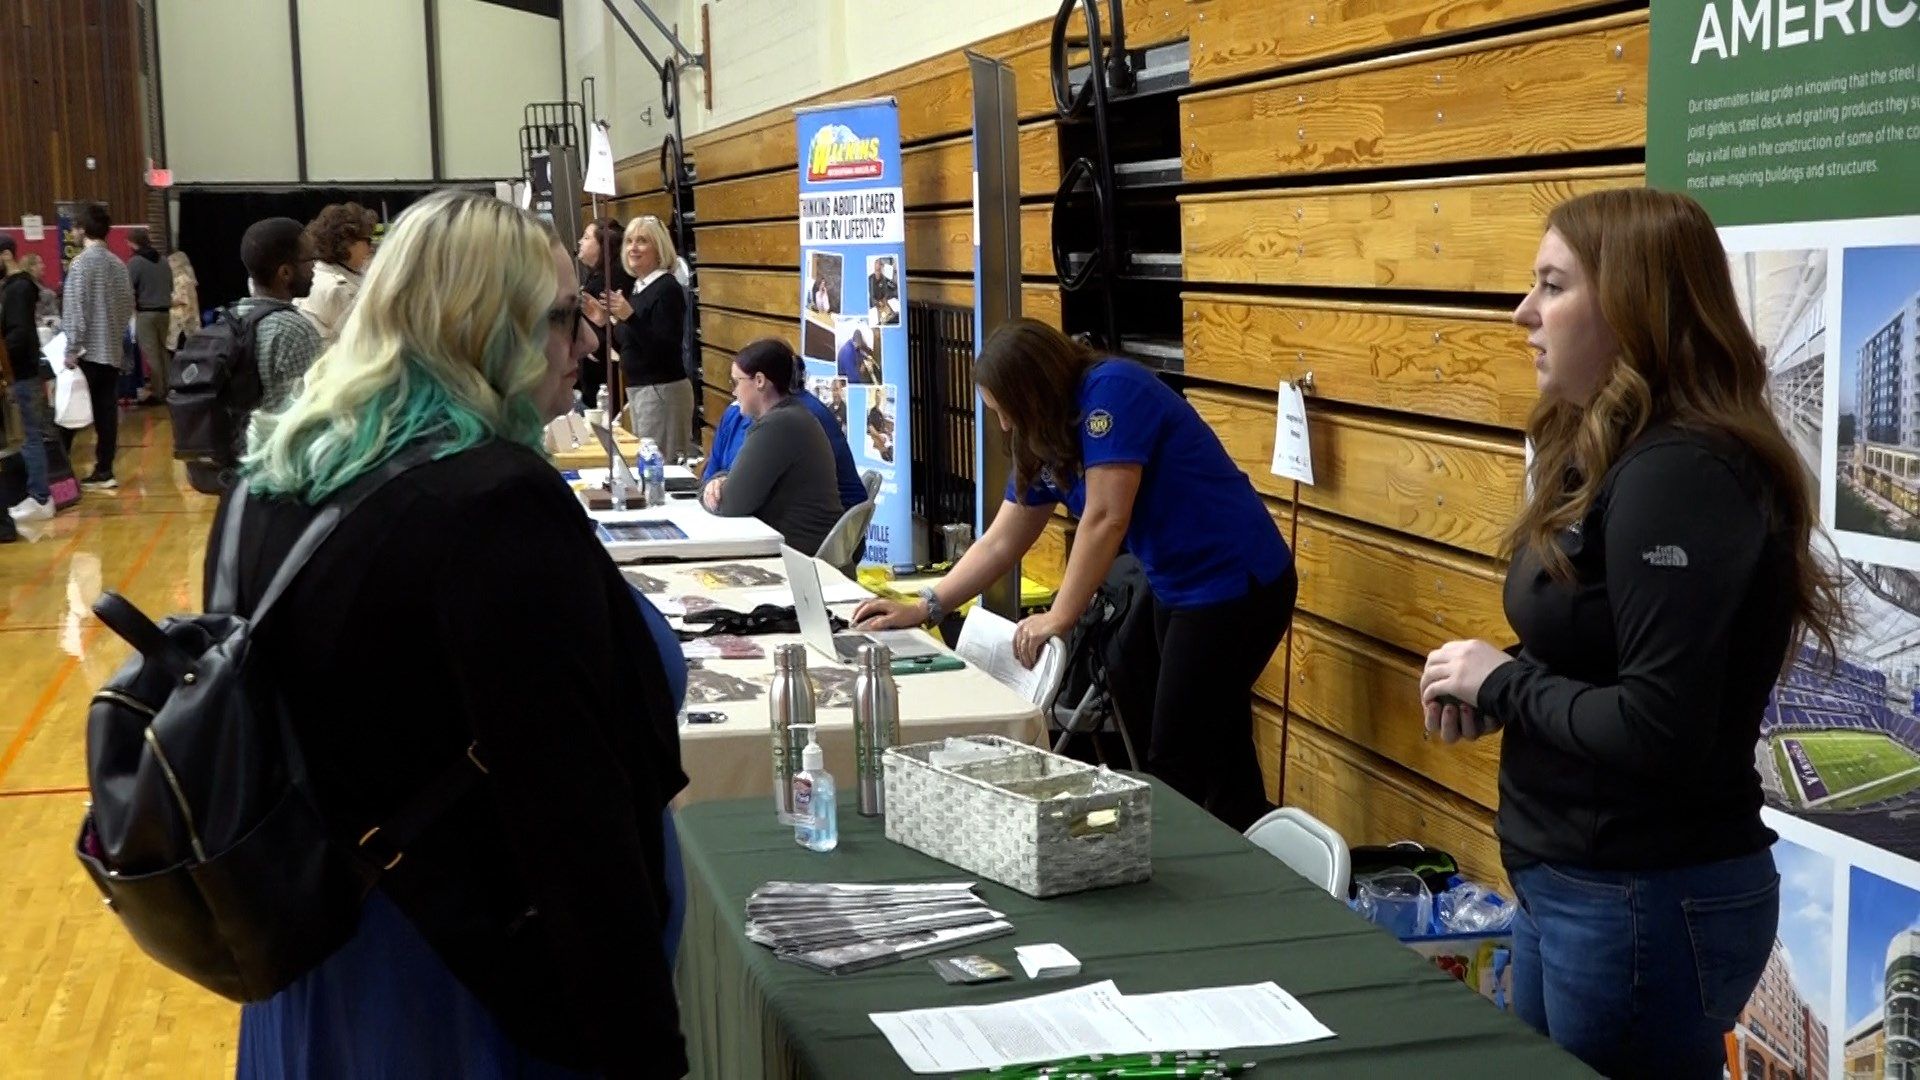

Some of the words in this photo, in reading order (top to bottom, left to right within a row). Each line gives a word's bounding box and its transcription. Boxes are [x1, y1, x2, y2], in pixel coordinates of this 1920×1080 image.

[1688, 99, 1704, 114] Our
[1704, 93, 1749, 111] teammates
[1750, 89, 1770, 104] take
[1771, 84, 1794, 105] pride
[1795, 83, 1803, 96] in
[1804, 77, 1847, 94] knowing
[1849, 72, 1868, 89] that
[1871, 69, 1886, 84] the
[1889, 64, 1915, 83] steel
[1738, 115, 1759, 132] steel
[1785, 109, 1802, 126] and
[1803, 104, 1839, 128] grating
[1841, 99, 1884, 120] products
[1885, 96, 1910, 114] they
[1687, 150, 1705, 168] play
[1705, 151, 1712, 164] a
[1713, 145, 1730, 162] vital
[1731, 144, 1747, 159] role
[1748, 142, 1757, 157] in
[1758, 140, 1774, 156] the
[1774, 133, 1832, 154] construction
[1834, 131, 1845, 148] of
[1847, 131, 1874, 147] some
[1875, 126, 1886, 144] of
[1887, 125, 1904, 142] the
[1687, 175, 1708, 189] most
[1709, 169, 1764, 188] awe-inspiring
[1765, 164, 1805, 184] buildings
[1806, 162, 1825, 179] and
[833, 195, 858, 216] ABOUT
[859, 195, 865, 214] A
[865, 193, 896, 215] CAREER
[806, 221, 813, 240] IN
[815, 220, 829, 240] THE
[831, 219, 843, 240] RV
[844, 217, 886, 239] LIFESTYLE?
